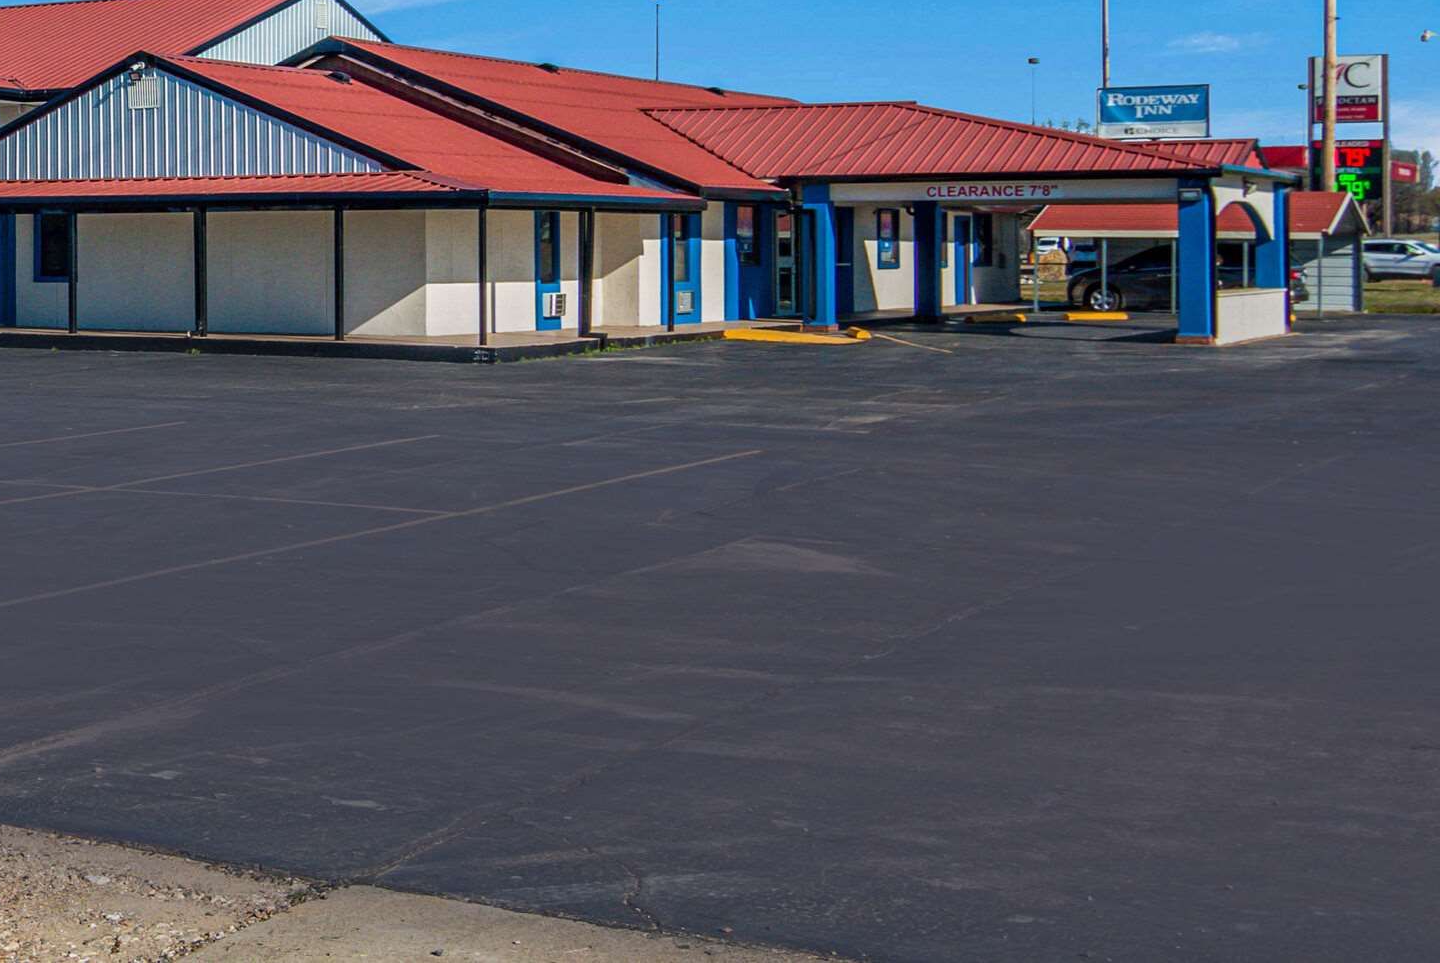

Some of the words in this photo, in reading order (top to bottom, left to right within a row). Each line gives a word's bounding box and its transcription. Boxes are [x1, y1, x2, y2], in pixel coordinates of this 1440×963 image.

[1107, 93, 1199, 106] RODEWAY
[1135, 104, 1172, 119] INN
[926, 185, 1024, 198] CLEARANCE
